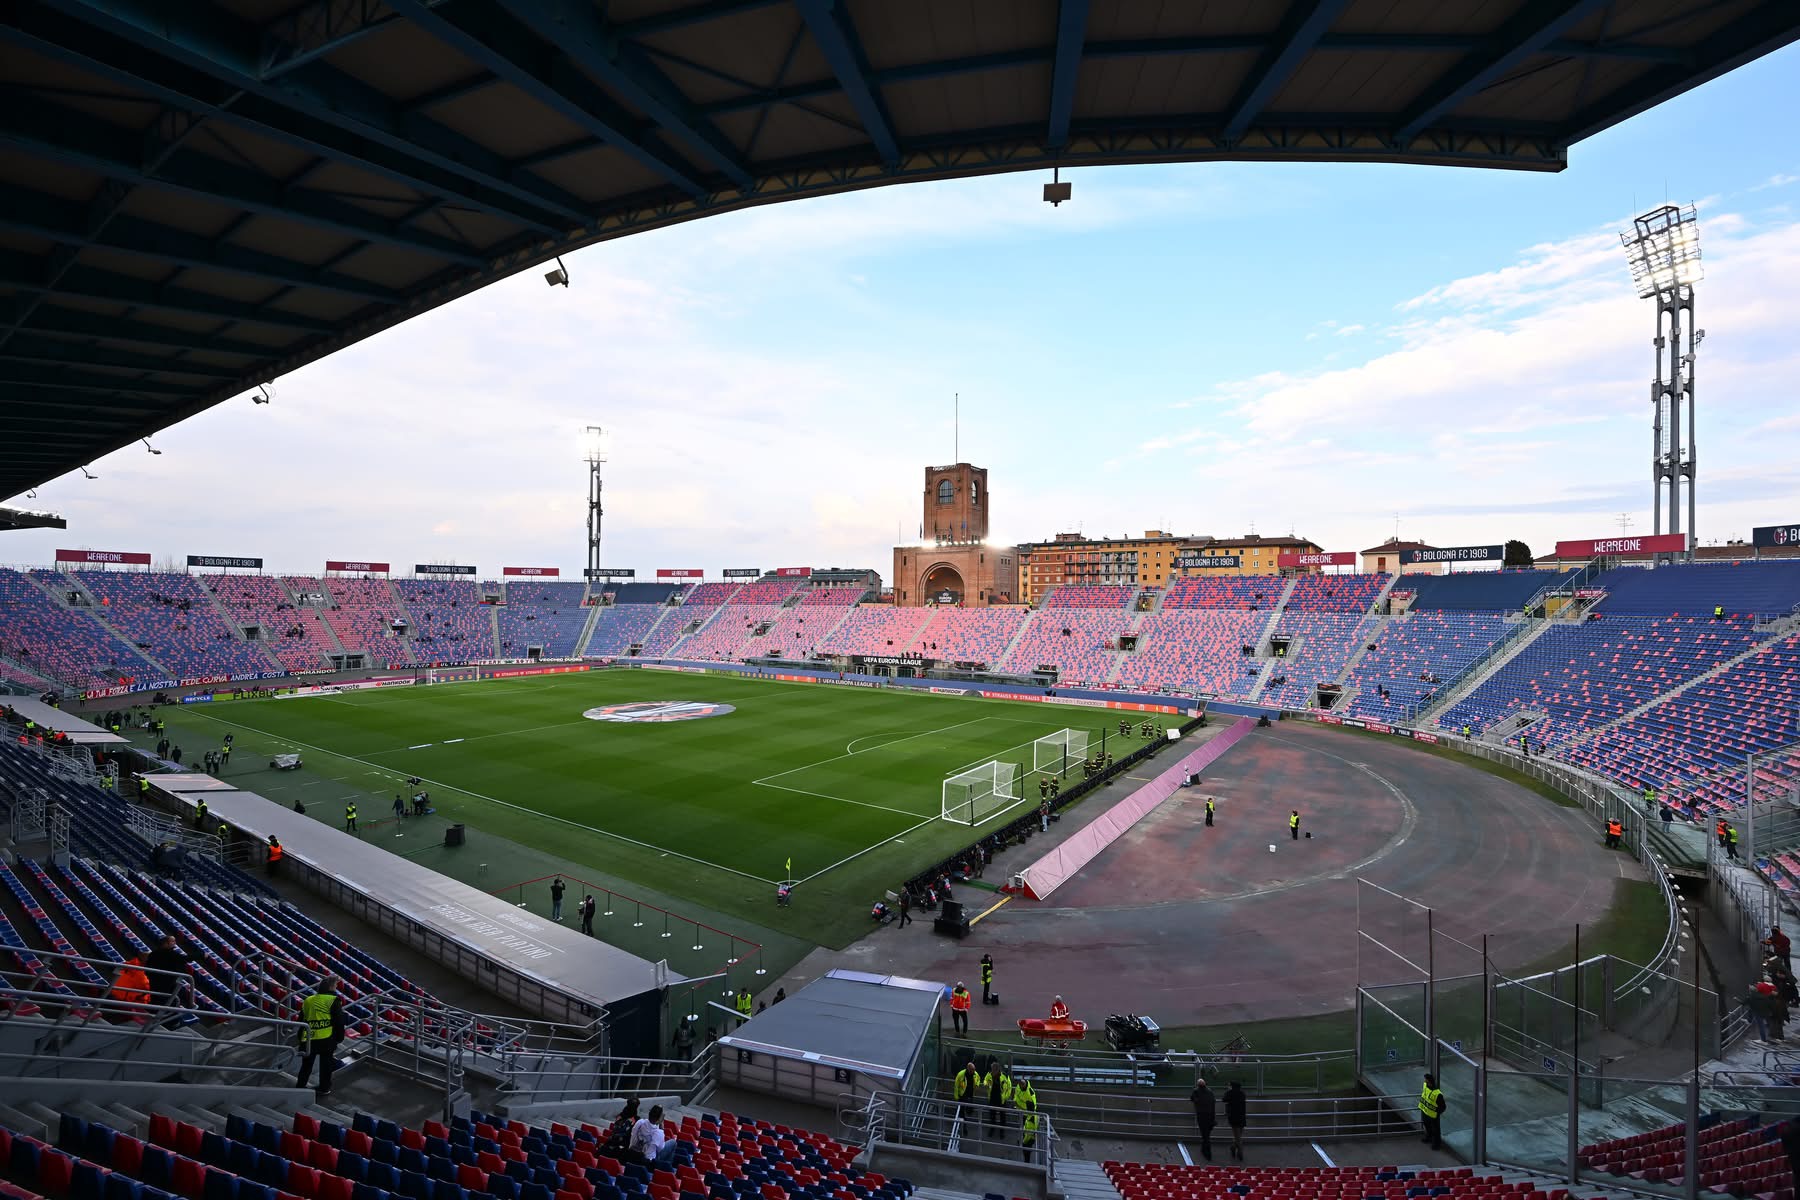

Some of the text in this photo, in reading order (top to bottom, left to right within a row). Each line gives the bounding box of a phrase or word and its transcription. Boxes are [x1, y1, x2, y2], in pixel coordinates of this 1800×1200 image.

[1594, 539, 1641, 553] WEAREONE
[87, 552, 123, 562] WEAREONE
[1299, 555, 1332, 564] WEAREONE
[1423, 548, 1488, 561] BOLOGNA FC 1909
[205, 557, 232, 565] BOLOGNA
[233, 558, 240, 566] FC
[1185, 557, 1234, 567] BOLOGNA FC 1909
[345, 563, 371, 571] WEAREONE
[289, 668, 336, 676] COMMANDOS
[108, 685, 128, 695] FORZA
[129, 684, 134, 693] E
[137, 683, 147, 692] LA
[149, 680, 178, 690] NOSTRA
[180, 678, 200, 686] FEDE
[202, 675, 227, 685] CURVA
[230, 672, 258, 681] ANDREA
[262, 671, 285, 679] COSTA
[494, 933, 552, 960] PLATINO
